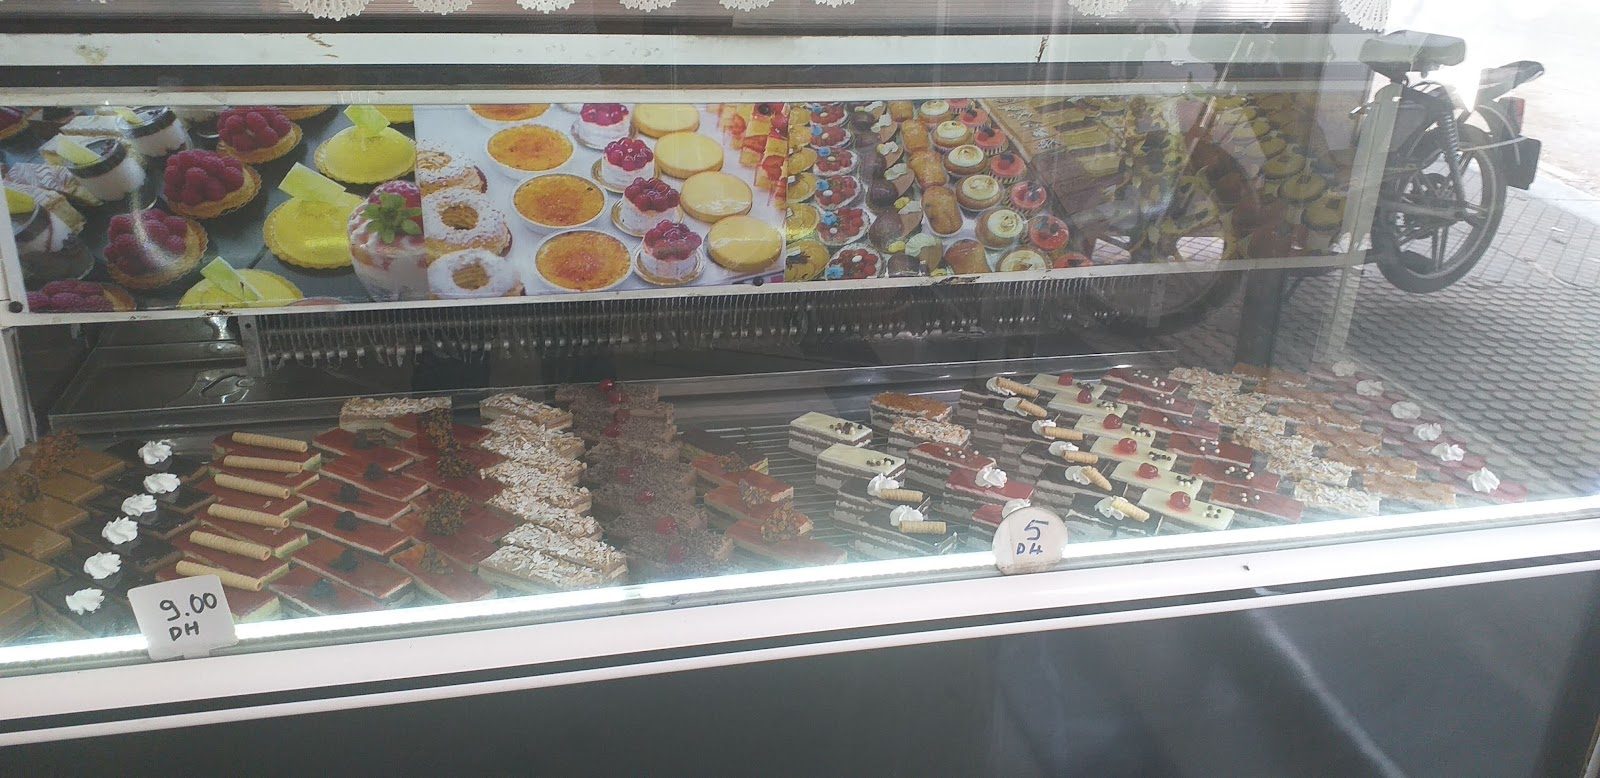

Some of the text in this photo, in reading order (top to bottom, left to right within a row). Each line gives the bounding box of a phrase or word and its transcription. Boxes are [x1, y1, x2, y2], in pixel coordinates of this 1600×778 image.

[1023, 519, 1049, 541] 5
[159, 592, 218, 622] 9.00
[168, 620, 200, 642] DH
